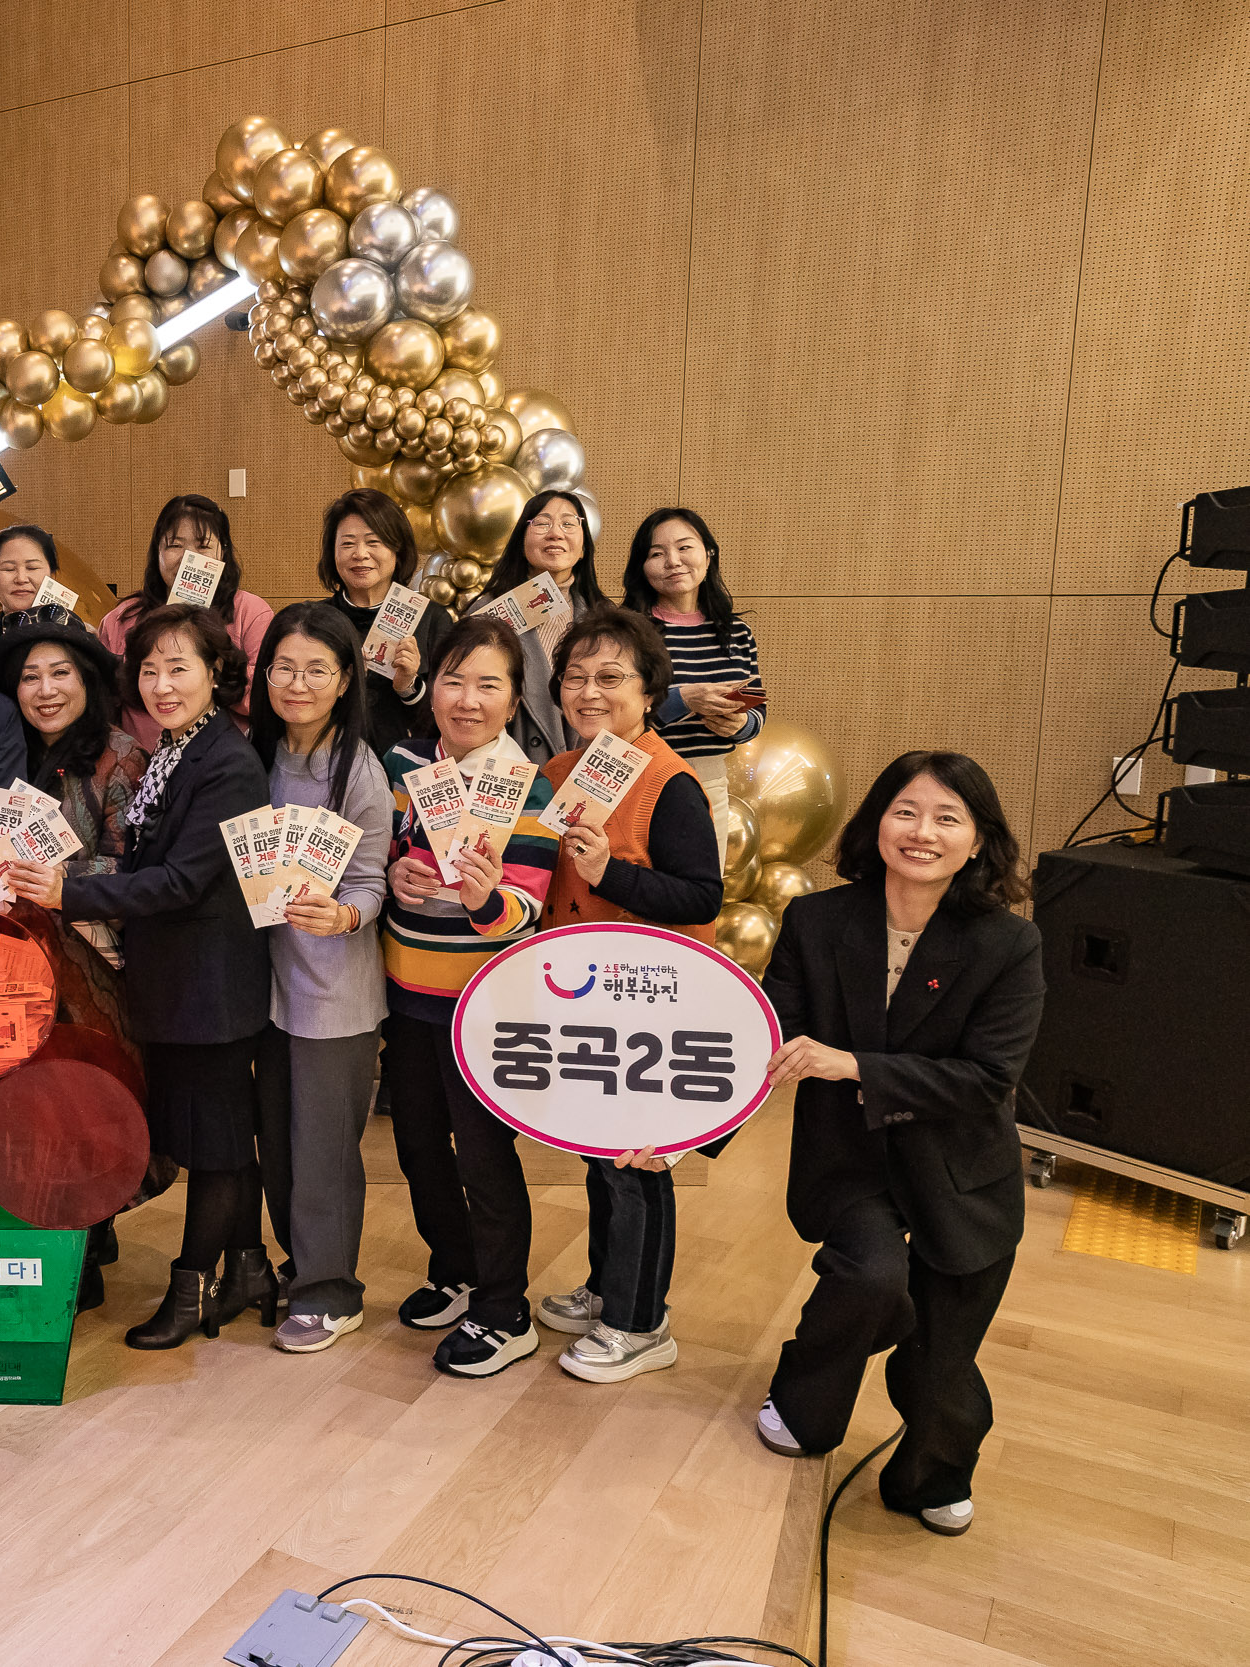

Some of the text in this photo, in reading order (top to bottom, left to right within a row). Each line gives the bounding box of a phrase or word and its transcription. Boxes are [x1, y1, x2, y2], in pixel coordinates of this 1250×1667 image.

[178, 579, 210, 596] 겨울나기
[180, 570, 213, 589] 따뜻한
[381, 612, 411, 632] 겨울나기
[384, 602, 416, 625] 따뜻한
[594, 747, 610, 760] 2026
[481, 772, 499, 783] 2026
[580, 764, 622, 793] 겨울나기
[586, 753, 630, 785] 따뜻한
[415, 786, 432, 797] 2026
[418, 785, 461, 809] 따뜻한
[473, 792, 518, 811] 겨울나기
[476, 780, 523, 802] 따뜻한
[423, 797, 465, 819] 겨울나기
[38, 817, 51, 833] 2026
[253, 831, 268, 840] 2026
[288, 823, 304, 832] 2026
[313, 825, 329, 837] 2026
[20, 828, 49, 865] 겨울나기
[27, 821, 60, 861] 따뜻한
[307, 832, 346, 861] 따뜻한
[303, 843, 341, 870] 겨울나기
[603, 963, 678, 979] 소통하며 발전하는
[603, 977, 678, 1004] 행복광진
[491, 1021, 736, 1103] 중곡2동
